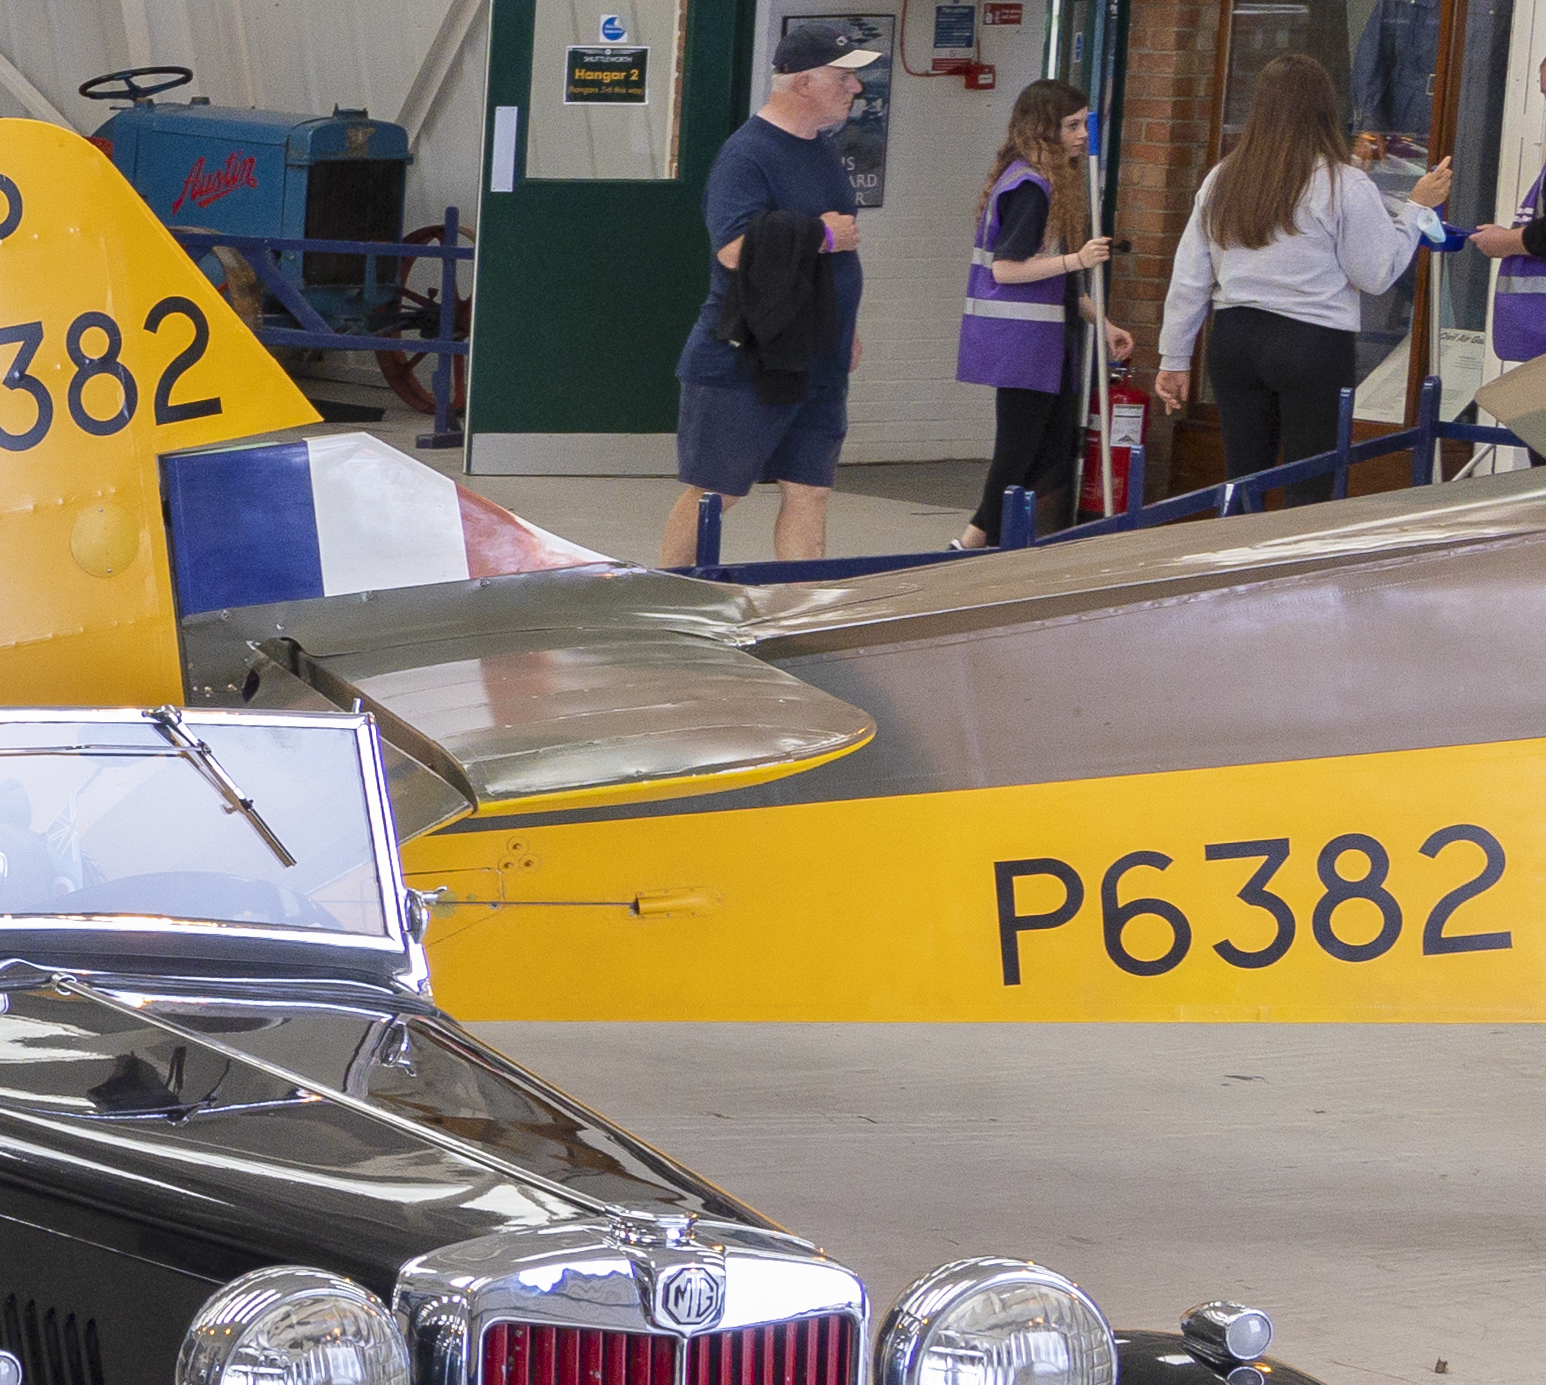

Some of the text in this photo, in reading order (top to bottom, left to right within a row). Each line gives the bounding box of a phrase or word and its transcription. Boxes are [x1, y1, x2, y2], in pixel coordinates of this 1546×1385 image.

[574, 68, 639, 83] Hangar 2
[172, 150, 258, 215] Austin
[993, 823, 1514, 987] P6382
[673, 1276, 715, 1318] MG
